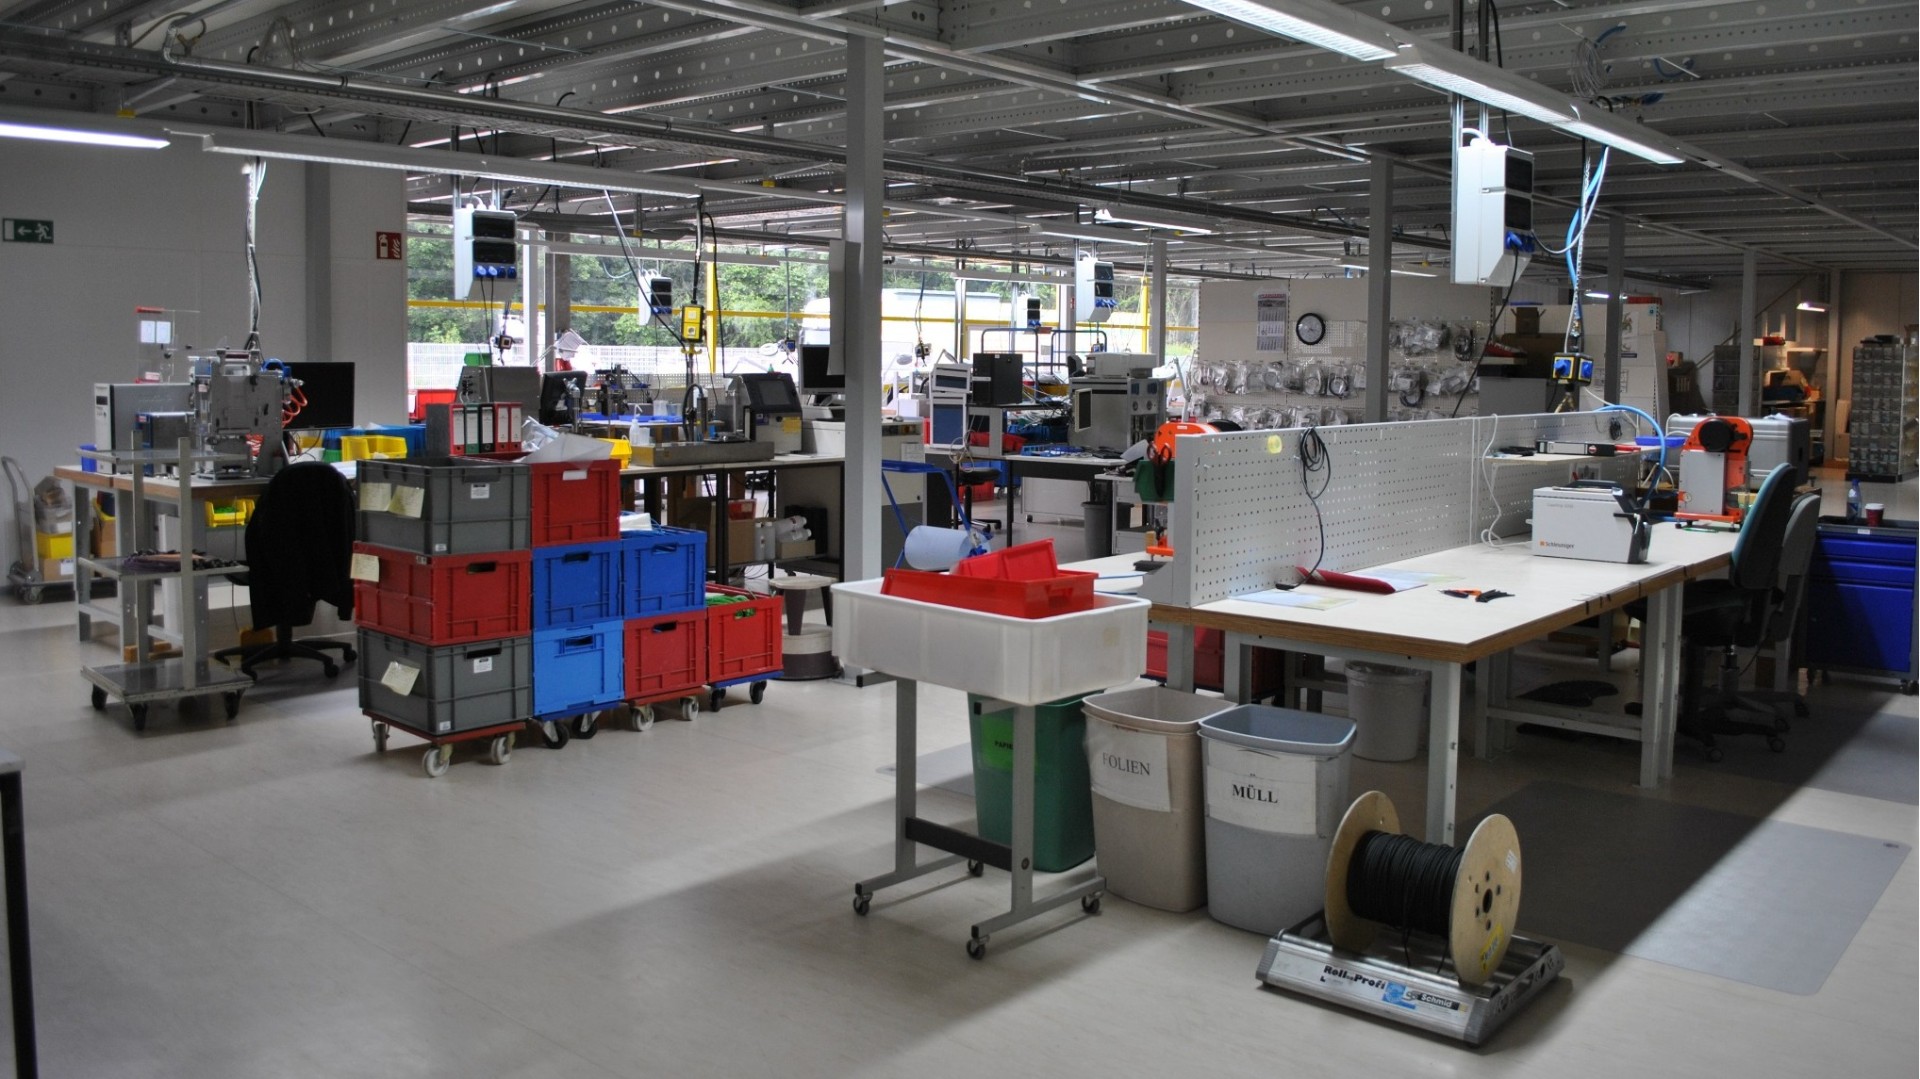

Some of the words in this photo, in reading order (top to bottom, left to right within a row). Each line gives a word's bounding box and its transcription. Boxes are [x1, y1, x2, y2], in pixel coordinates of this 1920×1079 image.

[994, 740, 1014, 751] PAPIE
[1102, 751, 1150, 776] FOLIEN
[1232, 783, 1278, 804] MÜLL
[1421, 993, 1452, 1008] Schmid
